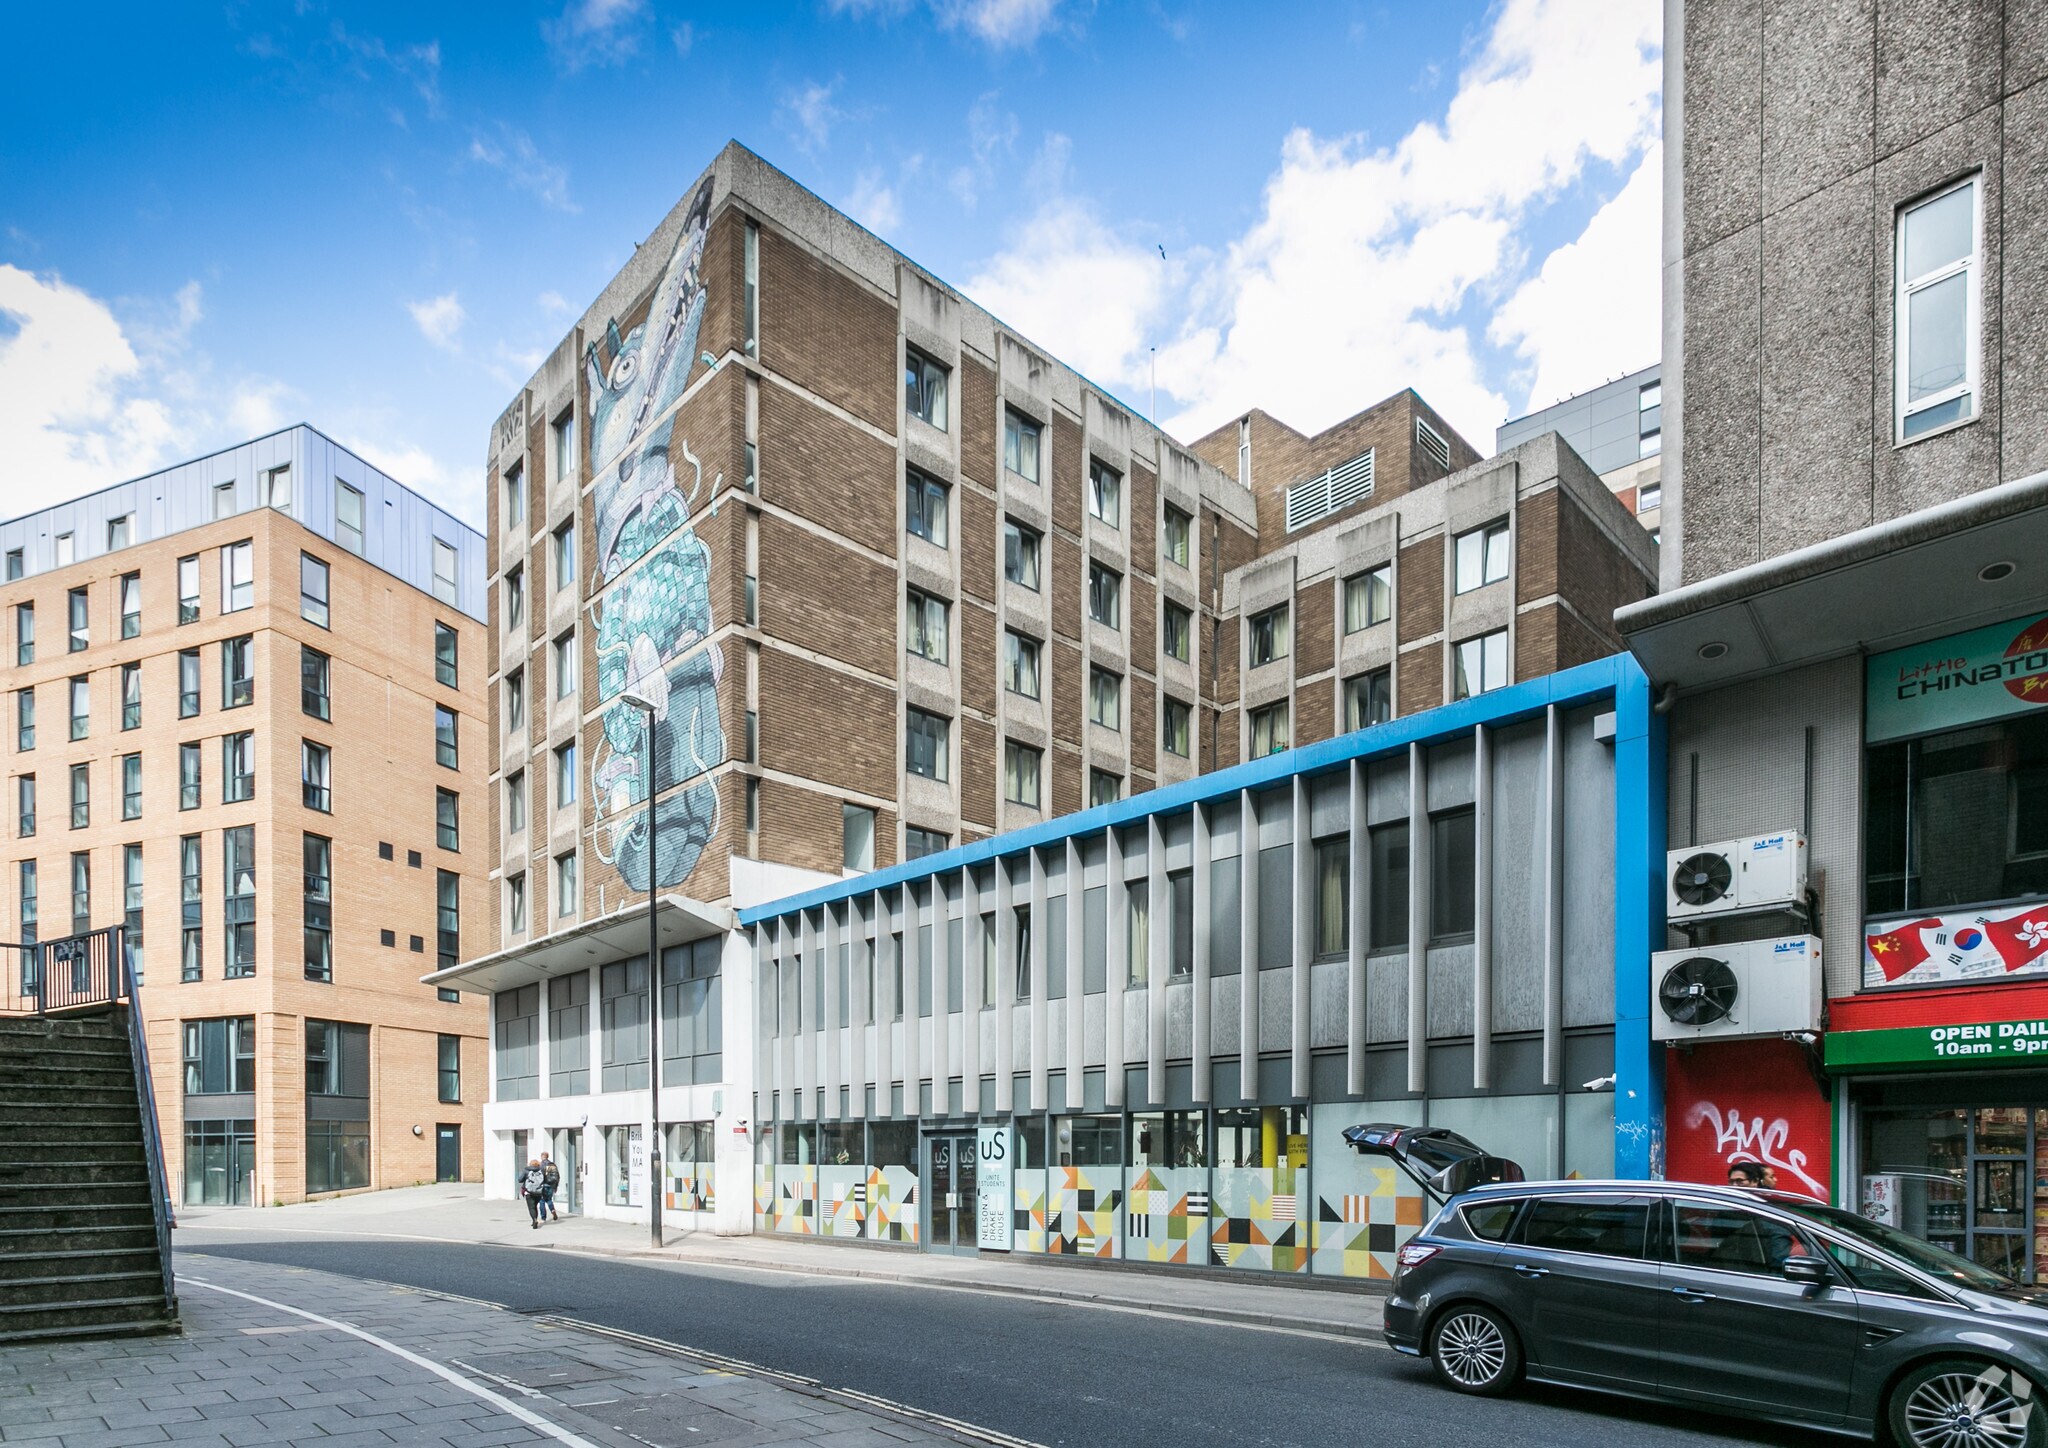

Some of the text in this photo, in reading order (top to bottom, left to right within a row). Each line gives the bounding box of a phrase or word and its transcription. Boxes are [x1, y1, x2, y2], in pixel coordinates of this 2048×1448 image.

[1899, 657, 1967, 682] Little
[1768, 837, 1784, 845] Hall
[1930, 1025, 1992, 1042] OPEN
[1934, 1041, 1993, 1056] 10am
[981, 1180, 1006, 1188] STUDENTS
[997, 1210, 1005, 1242] HOUSE
